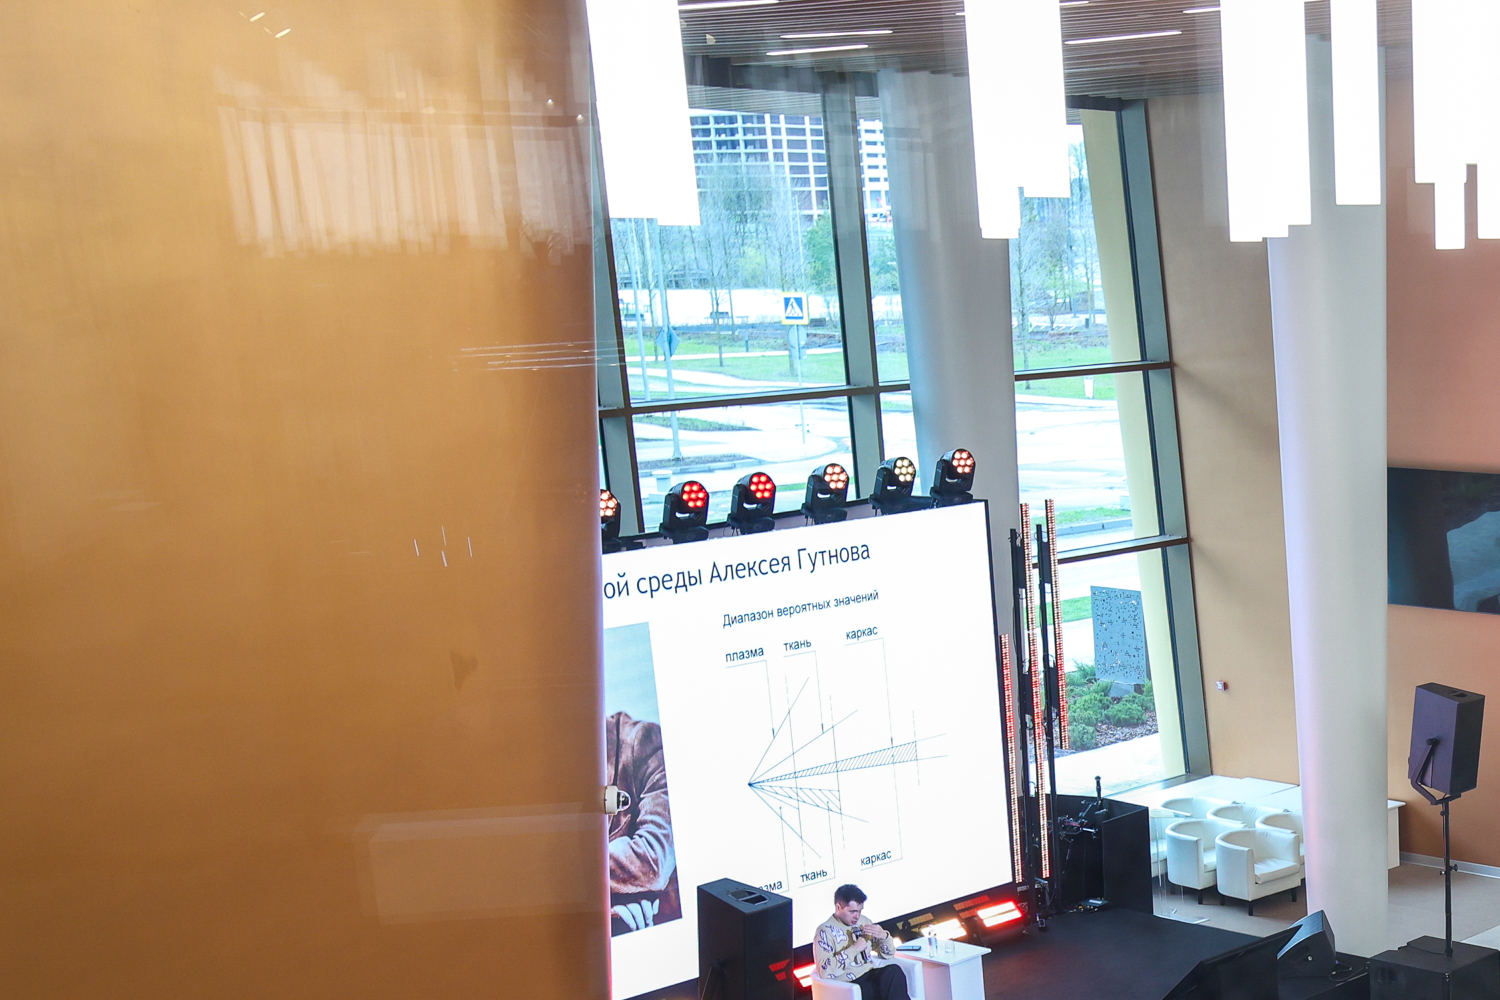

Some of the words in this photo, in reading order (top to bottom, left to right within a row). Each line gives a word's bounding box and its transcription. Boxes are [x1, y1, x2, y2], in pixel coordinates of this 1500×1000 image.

[636, 569, 702, 599] среды
[709, 555, 791, 584] Алексея
[797, 543, 871, 573] Гутнова
[723, 608, 774, 629] Диапазон
[776, 600, 831, 618] вероятных
[833, 589, 879, 608] значений
[845, 625, 878, 641] каркас
[783, 639, 812, 652] ткань
[725, 647, 764, 663] плазма
[860, 850, 892, 867] каркас
[800, 869, 828, 883] ткань
